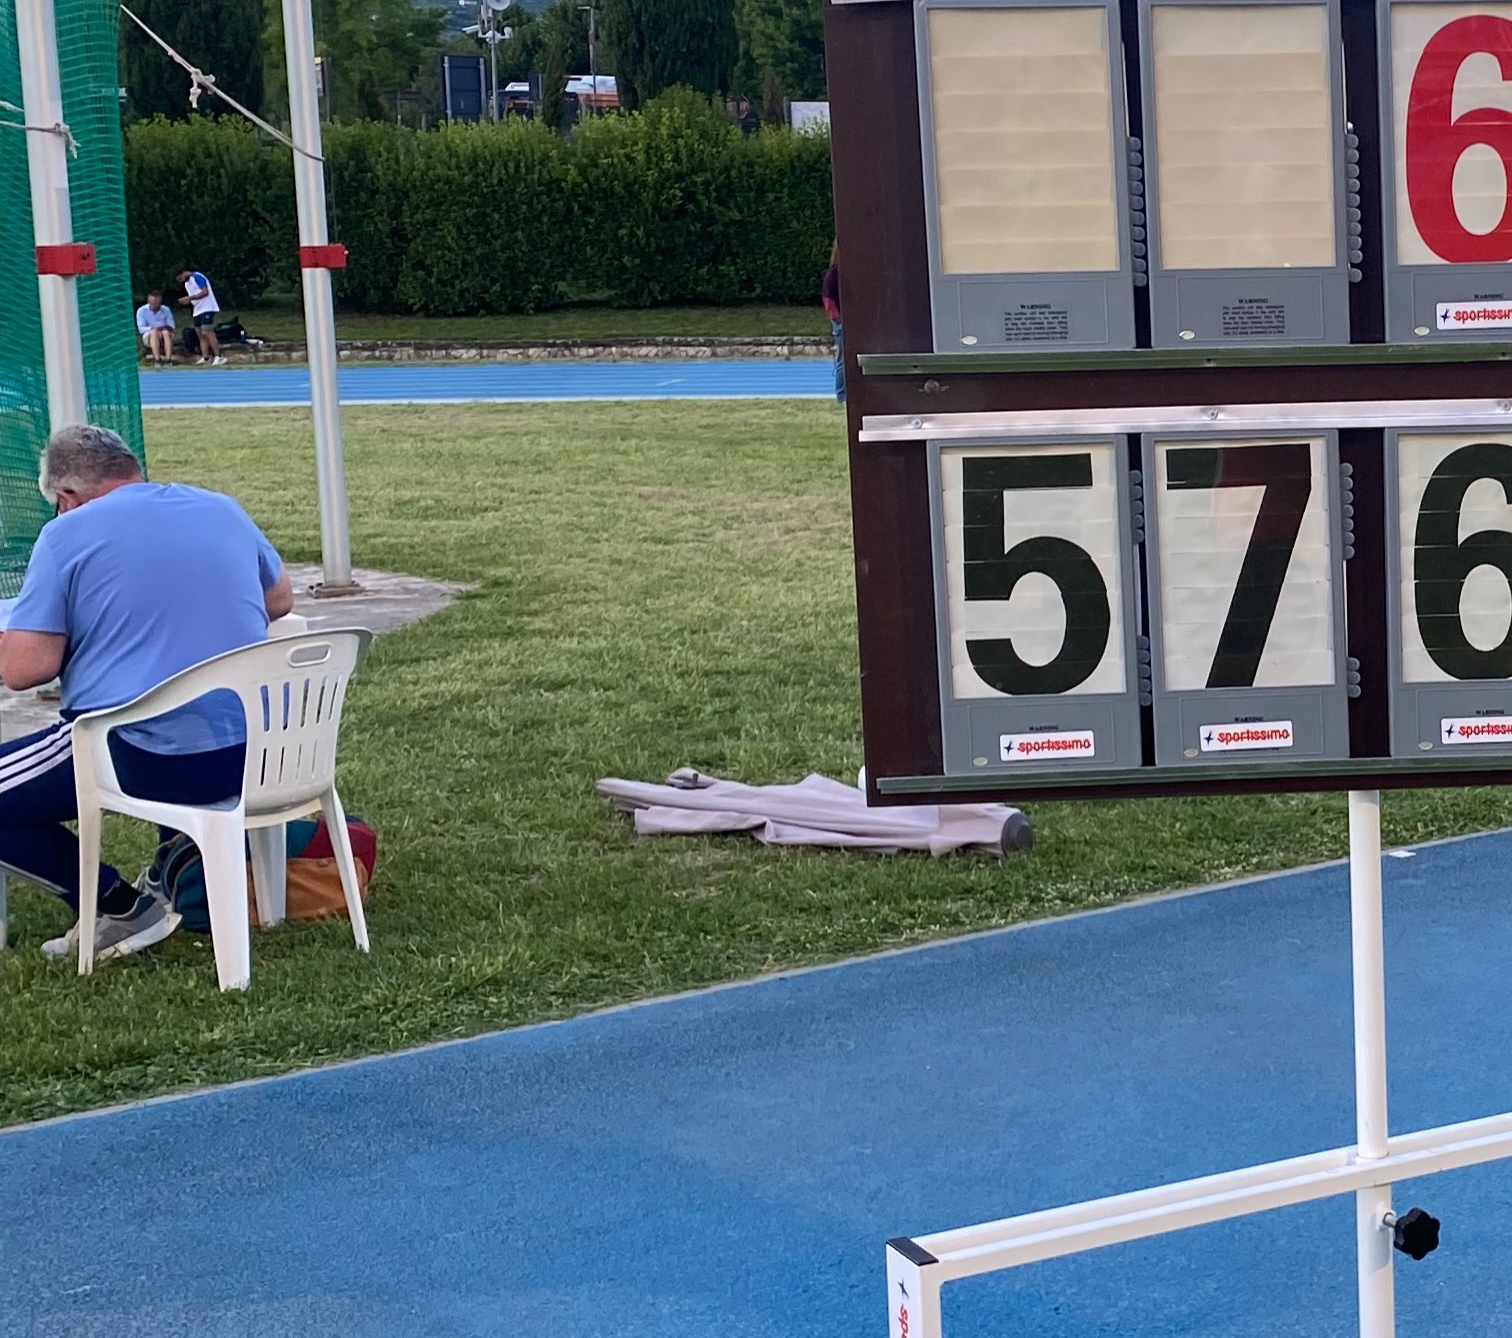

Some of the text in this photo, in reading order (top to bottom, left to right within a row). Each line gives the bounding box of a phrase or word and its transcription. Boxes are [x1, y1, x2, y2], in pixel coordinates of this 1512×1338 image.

[962, 452, 1111, 696] 5
[1165, 443, 1312, 689] 7
[1217, 728, 1290, 746] sportissimo
[1017, 738, 1091, 755] sportissimo
